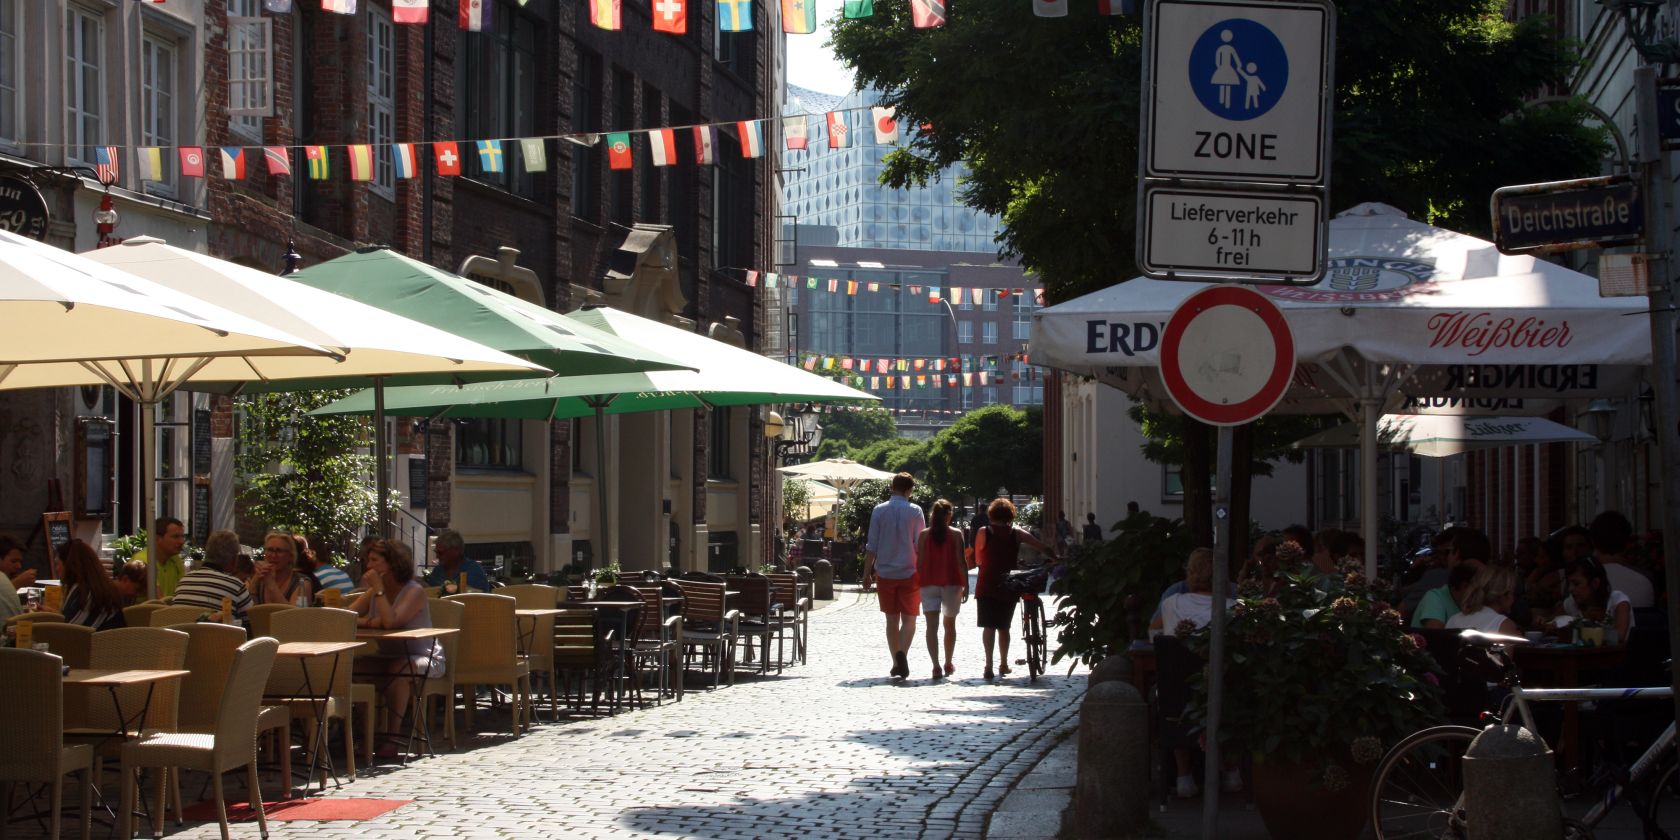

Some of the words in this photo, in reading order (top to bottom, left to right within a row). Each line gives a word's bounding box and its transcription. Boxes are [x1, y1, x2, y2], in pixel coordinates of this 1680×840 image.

[1194, 131, 1277, 160] ZONE
[1170, 202, 1299, 226] Lieferverkehr
[1508, 195, 1630, 234] Deichstraße
[1250, 229, 1261, 247] h
[1216, 247, 1249, 266] frei
[1427, 311, 1574, 357] Weißbier
